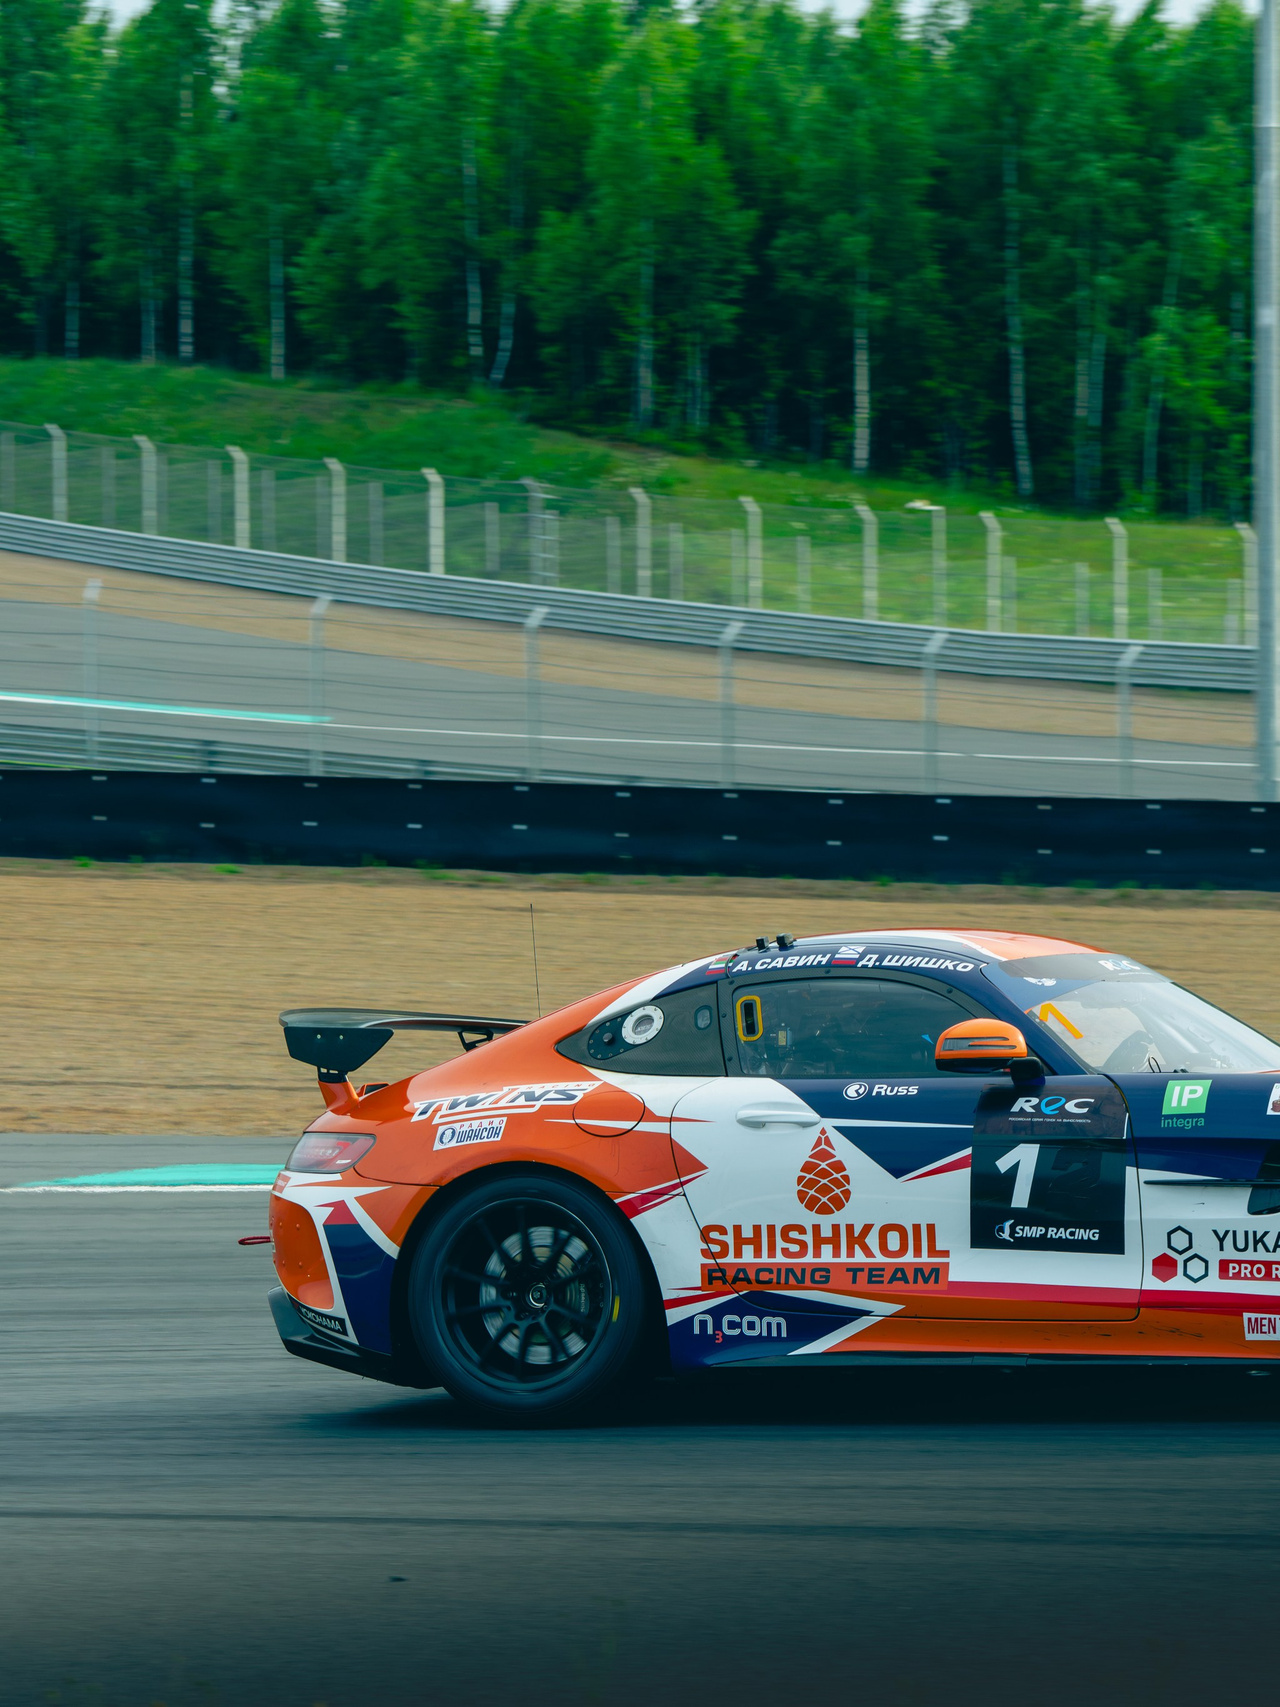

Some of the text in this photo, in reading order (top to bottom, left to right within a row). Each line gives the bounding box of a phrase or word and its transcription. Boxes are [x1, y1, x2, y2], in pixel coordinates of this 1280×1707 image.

[732, 953, 831, 973] А.САВИН
[857, 953, 975, 973] Д.ШИШКО
[417, 1088, 591, 1117] TWINS
[1171, 1085, 1203, 1107] IP
[459, 1119, 505, 1130] РАДИО
[1161, 1117, 1205, 1129] integra
[456, 1126, 503, 1143] ШАНСОН
[995, 1143, 1040, 1208] 1
[700, 1223, 950, 1259] SHISHKOIL
[1015, 1226, 1100, 1241] SMP RACING
[708, 1267, 940, 1285] RACING TEAM
[1228, 1263, 1266, 1278] PRO
[1247, 1317, 1277, 1334] MEN
